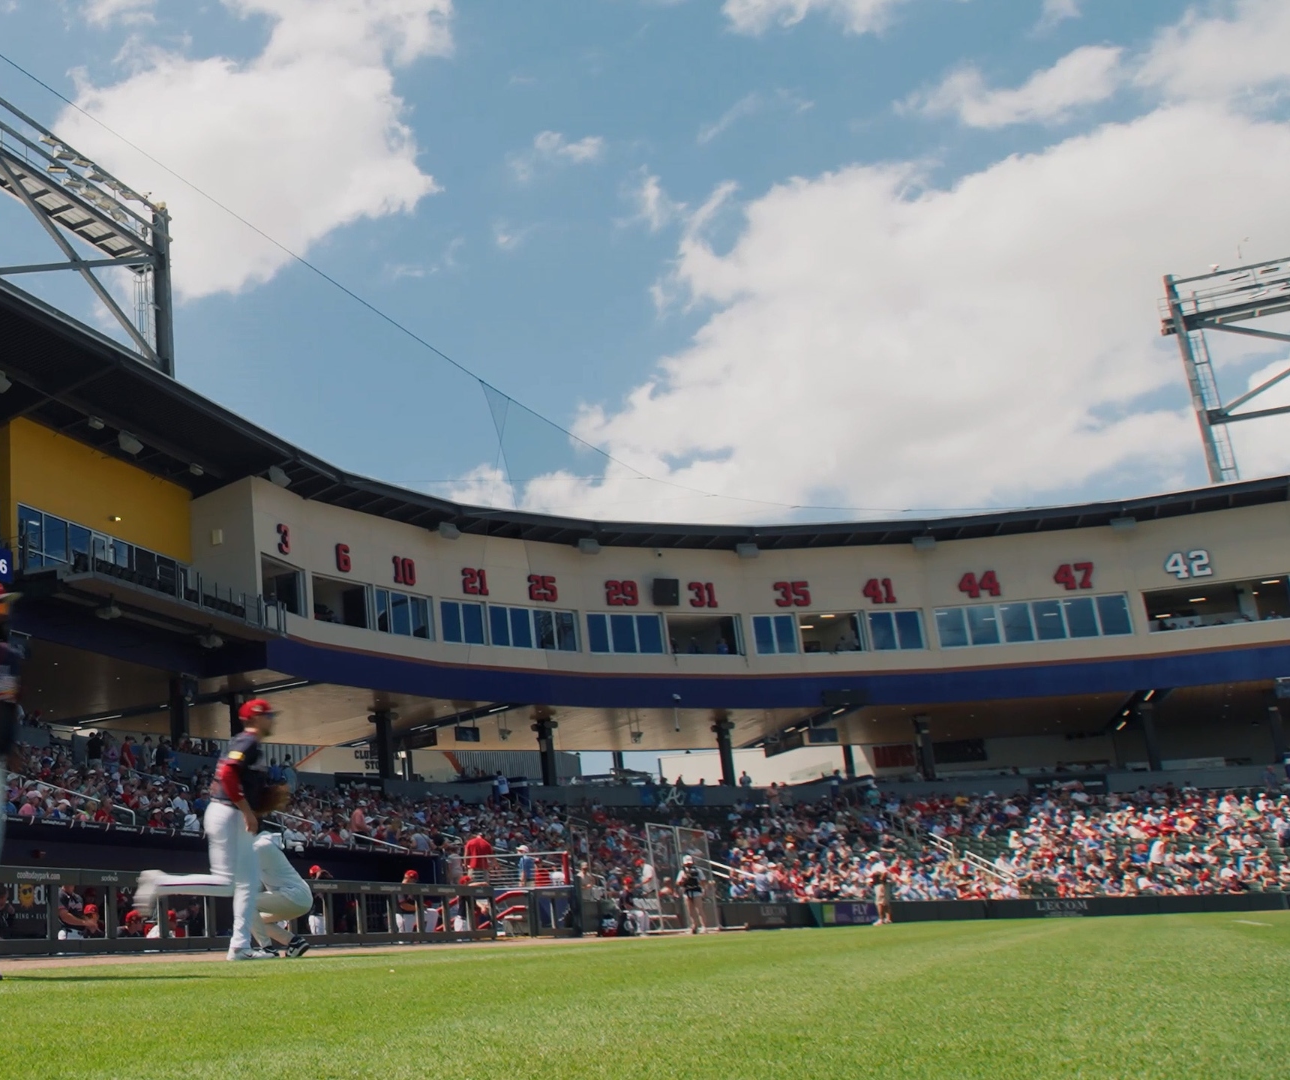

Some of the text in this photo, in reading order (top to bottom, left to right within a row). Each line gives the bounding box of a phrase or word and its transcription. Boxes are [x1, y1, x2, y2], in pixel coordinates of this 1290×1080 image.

[277, 523, 290, 555] 3
[335, 543, 351, 572] 6
[392, 555, 416, 586] 10
[1165, 549, 1213, 580] 42
[462, 567, 489, 595] 21
[527, 574, 558, 602] 25
[959, 570, 1001, 598] 44
[1053, 562, 1094, 590] 47
[605, 580, 639, 606] 29
[688, 582, 718, 608] 31
[773, 581, 811, 607] 35
[863, 578, 897, 604] 41
